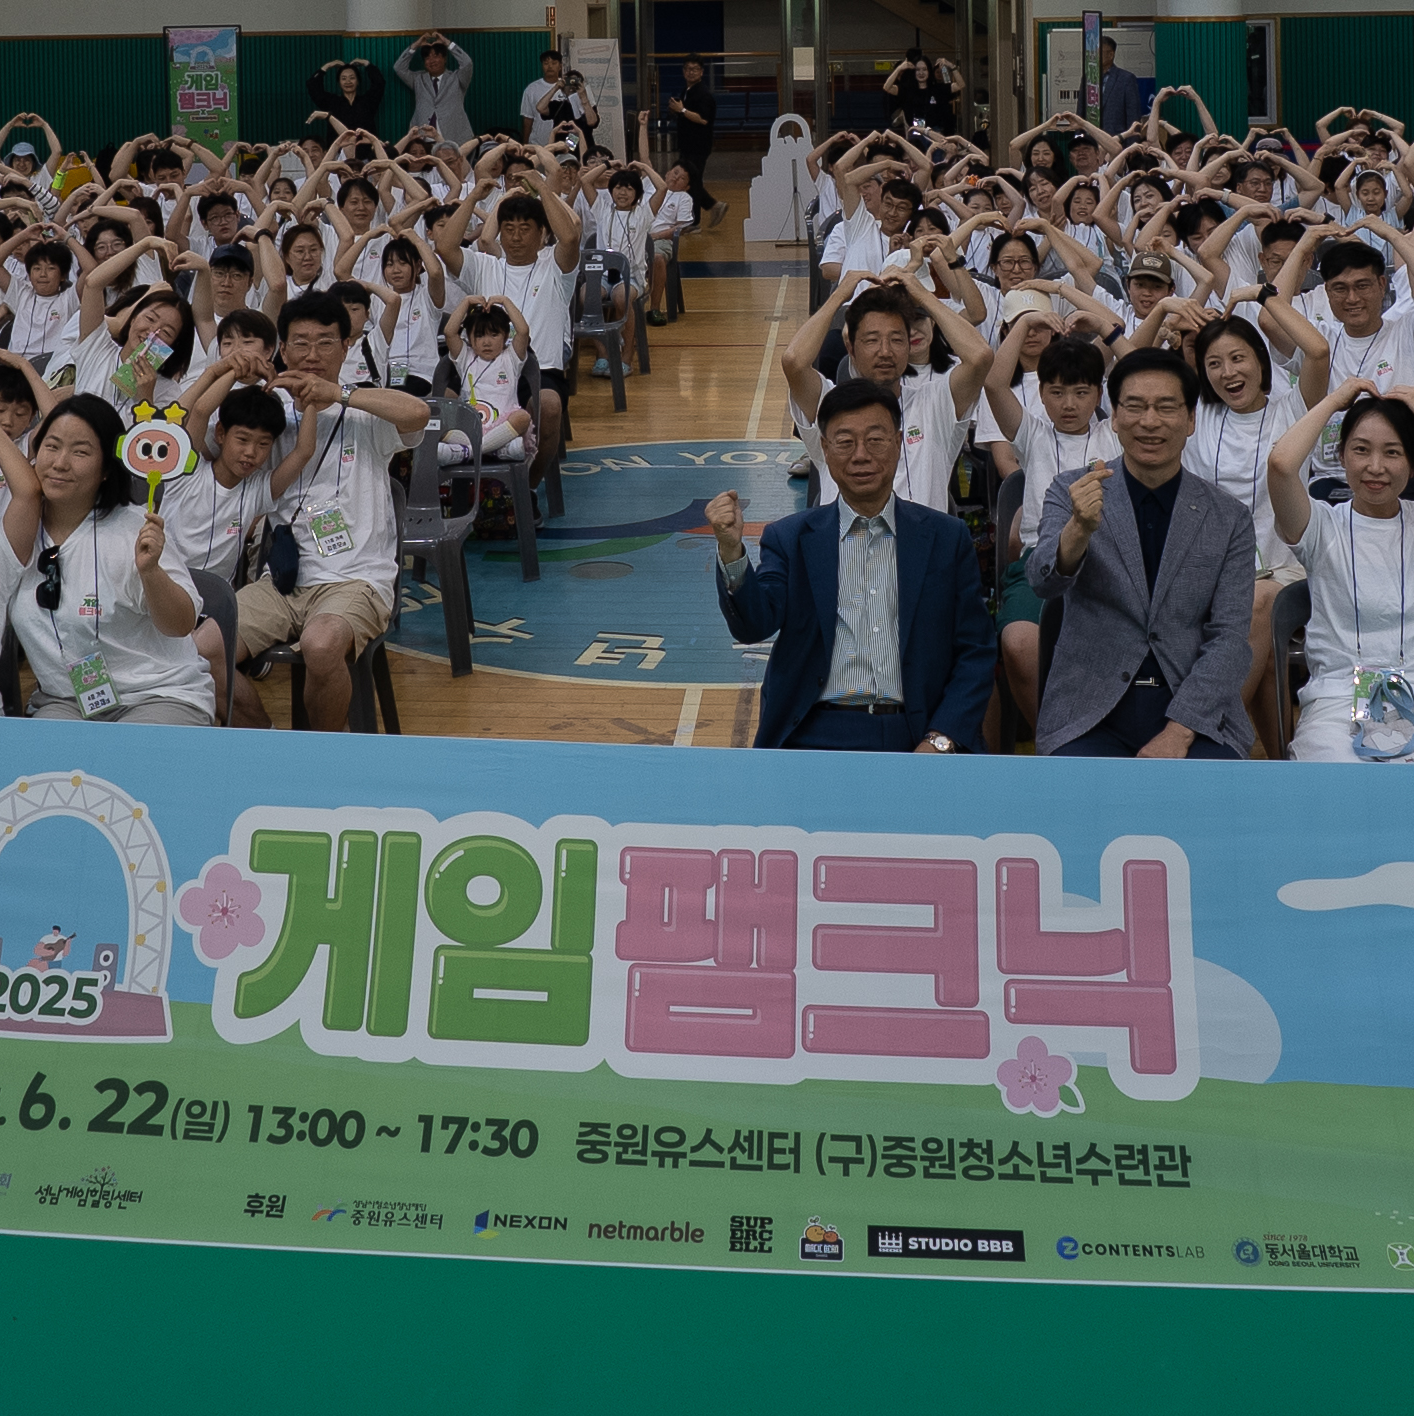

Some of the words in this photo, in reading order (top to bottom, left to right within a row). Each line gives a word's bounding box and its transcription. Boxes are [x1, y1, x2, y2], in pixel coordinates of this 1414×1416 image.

[186, 73, 220, 91] 게임
[231, 828, 599, 1048] 게임
[615, 845, 1177, 1076] 팸크닉
[18, 1070, 72, 1131] 6.
[246, 1104, 366, 1150] 13:00
[415, 1113, 540, 1159] 17:30
[574, 1121, 802, 1175] 중원유스센터
[814, 1131, 1192, 1189] (구)중원청소년수련관
[34, 1184, 144, 1210] 성남게임힐링센터
[242, 1192, 287, 1219] 후원
[349, 1209, 444, 1231] 중원유스센터
[492, 1213, 569, 1231] NEXON
[586, 1220, 706, 1244] netmarble
[729, 1215, 774, 1229] SUP
[729, 1229, 774, 1241] ERC
[1263, 1232, 1286, 1242] since
[1288, 1233, 1308, 1243] 1978
[729, 1241, 773, 1254] ELL
[907, 1237, 973, 1253] STUDIO
[977, 1238, 1014, 1254] BBB
[1264, 1242, 1360, 1263] 동서울대학교
